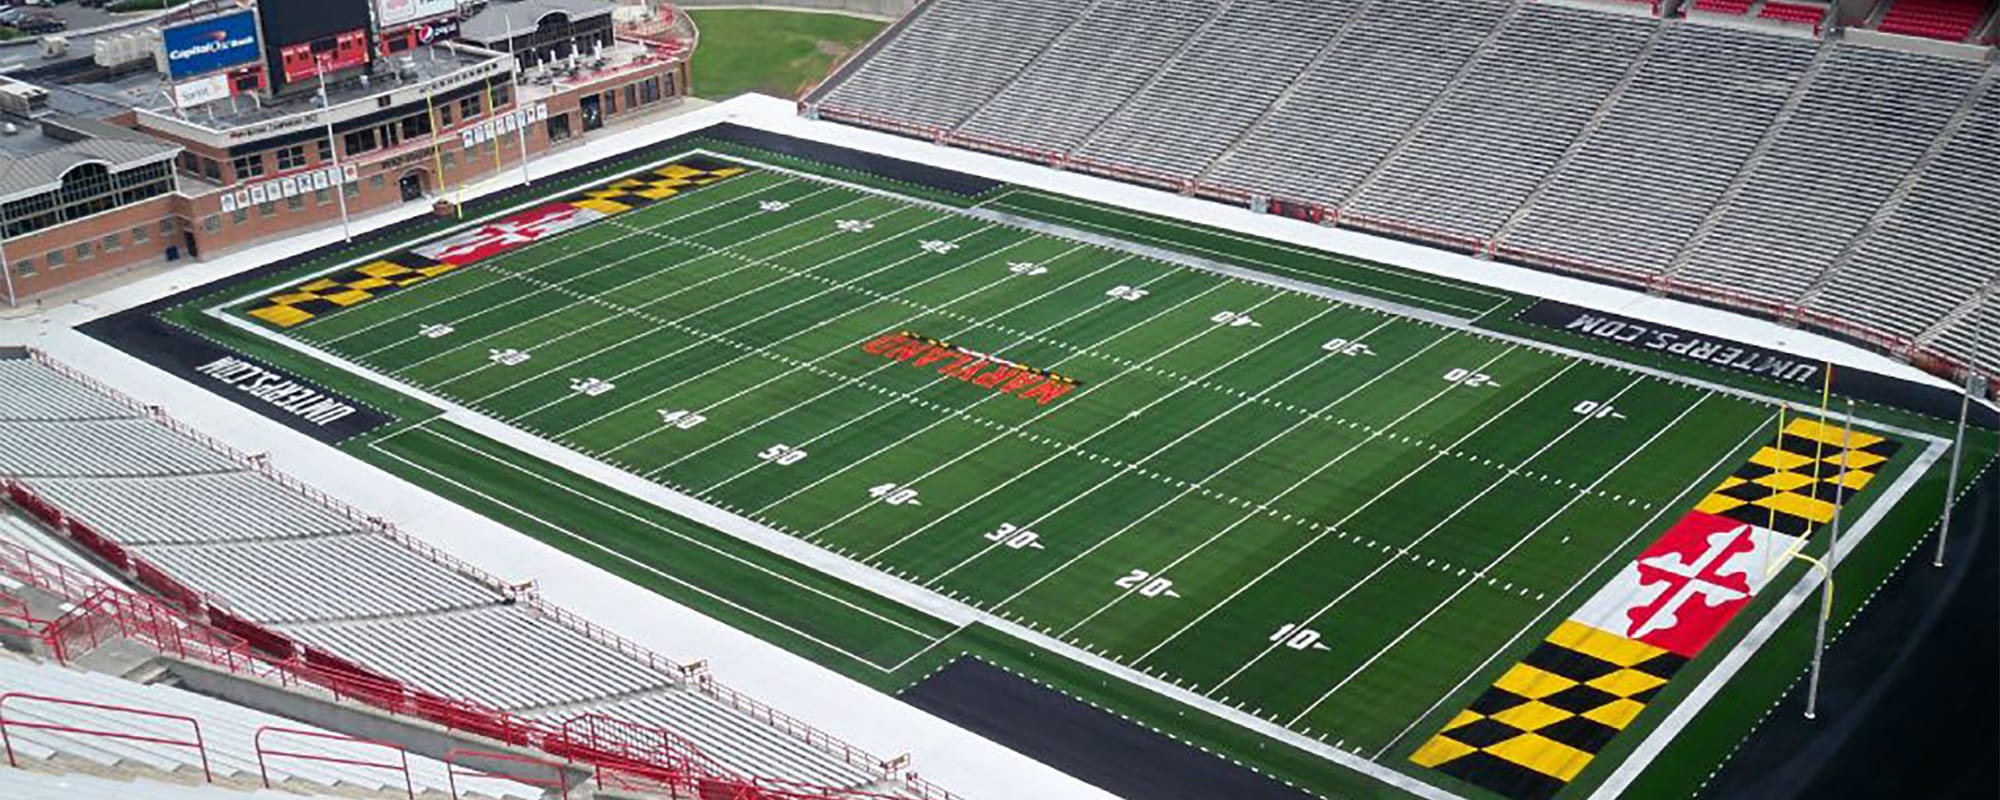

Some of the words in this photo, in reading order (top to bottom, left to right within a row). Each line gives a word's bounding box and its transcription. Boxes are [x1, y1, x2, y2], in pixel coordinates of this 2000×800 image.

[169, 42, 212, 60] Capital
[1321, 338, 1368, 356] 30
[1565, 303, 1818, 383] UMTERPS.COM
[862, 332, 1077, 406] MARYLAND
[1443, 368, 1491, 388] 20
[195, 355, 357, 427] UMTERPS.COM
[1573, 400, 1614, 419] 10
[757, 443, 807, 466] 50
[868, 483, 918, 506] 40
[984, 522, 1039, 550] 30
[1115, 569, 1173, 598] 20
[1268, 623, 1321, 650] 10
